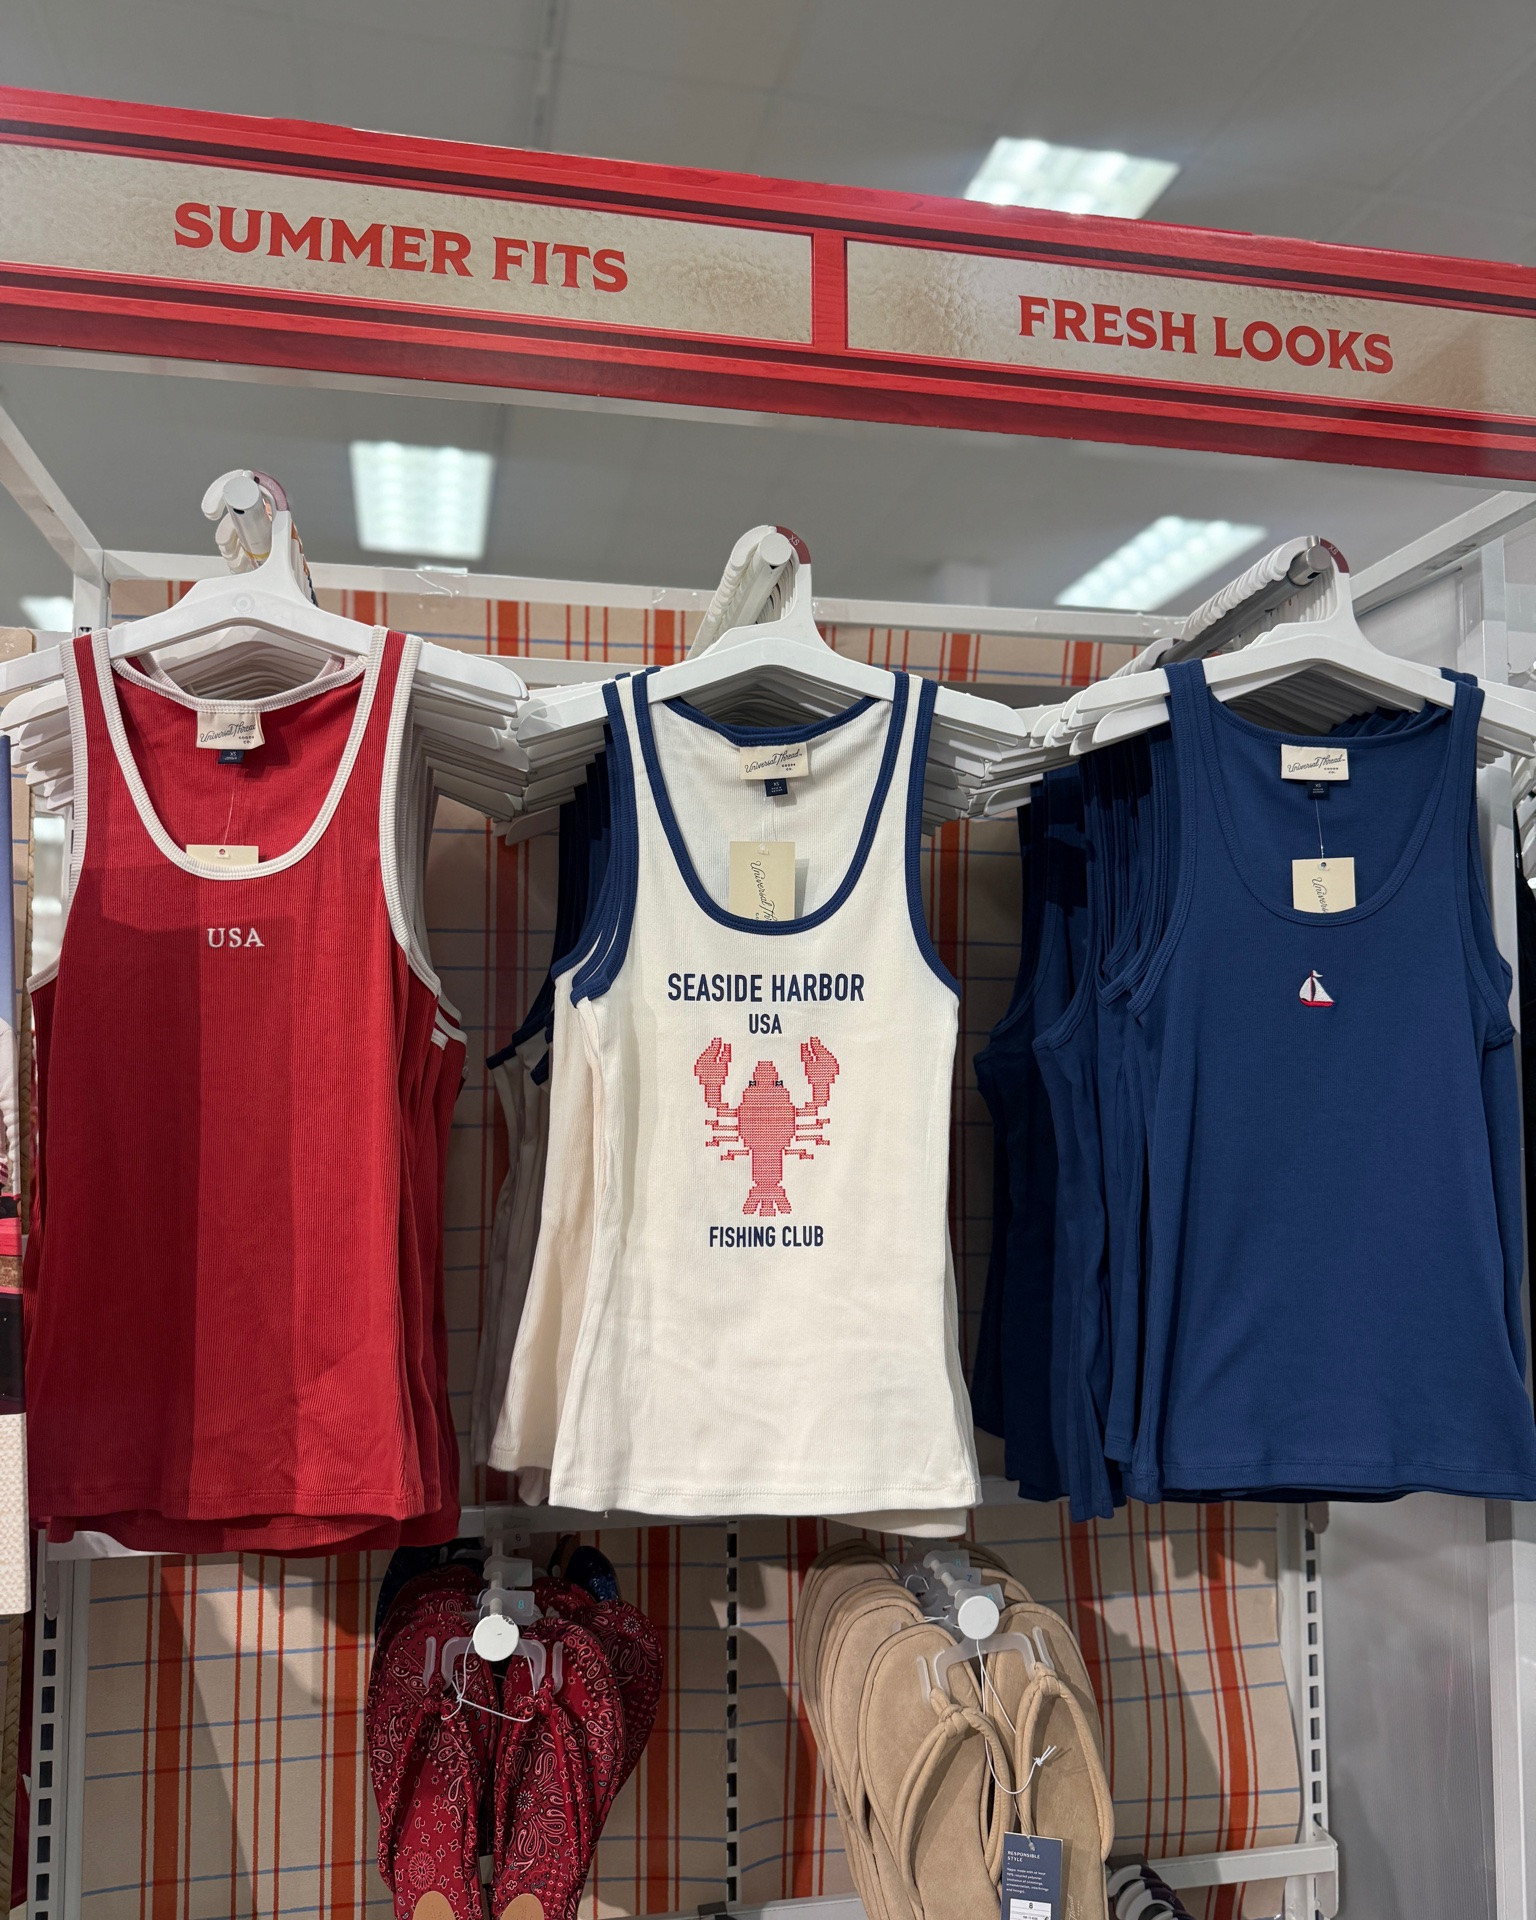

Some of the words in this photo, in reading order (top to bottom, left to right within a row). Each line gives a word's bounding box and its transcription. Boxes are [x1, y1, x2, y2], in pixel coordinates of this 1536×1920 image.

[174, 202, 473, 277] SUMMER
[492, 236, 629, 293] FITS
[1018, 295, 1198, 354] FRESH
[1213, 316, 1394, 374] LOOKS
[789, 534, 800, 546] XS
[1328, 544, 1338, 555] XS
[200, 725, 234, 743] Universal
[745, 755, 777, 774] Universal
[772, 748, 800, 766] Thread
[1287, 758, 1320, 773] Universal
[1315, 754, 1343, 769] Thread
[750, 860, 773, 906] Universal
[1311, 877, 1329, 913] Univers
[207, 927, 266, 948] USA
[668, 973, 763, 1003] SEASIDE
[771, 973, 865, 1003] HARBOR
[749, 1013, 782, 1034] USA
[709, 1226, 776, 1248] FISHING
[782, 1225, 824, 1247] CLUB
[518, 1600, 524, 1609] 8
[1007, 1850, 1040, 1860] RESPONSIBLE
